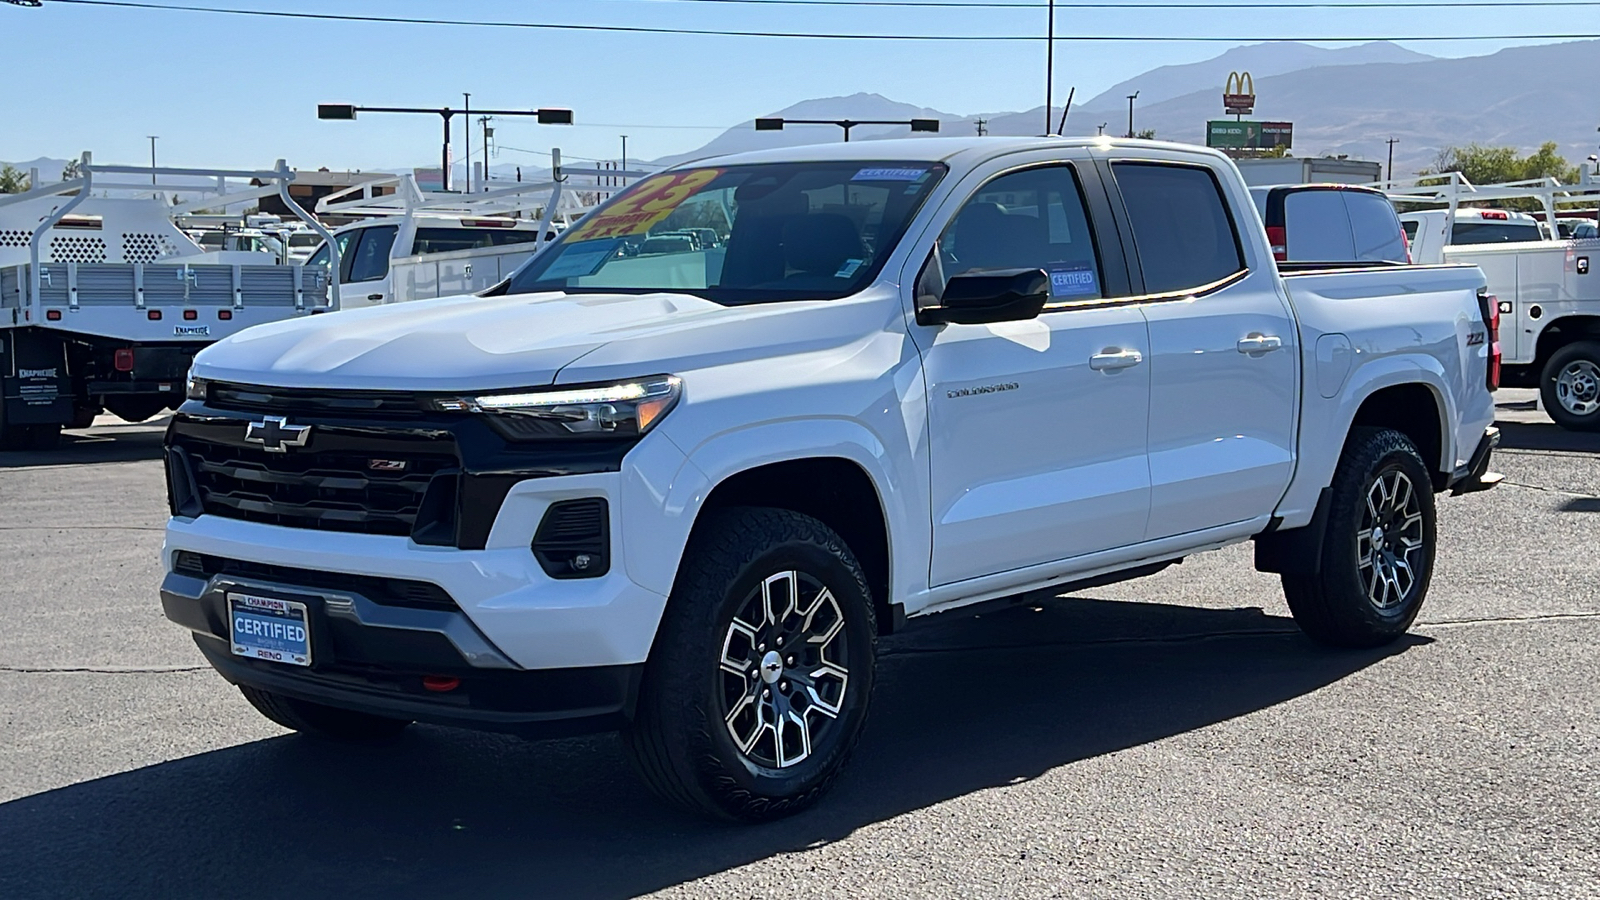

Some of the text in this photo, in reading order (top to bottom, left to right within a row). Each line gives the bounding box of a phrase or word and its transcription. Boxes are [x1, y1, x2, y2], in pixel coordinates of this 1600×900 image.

[859, 168, 922, 176] CERTIFIED
[600, 169, 719, 215] 23
[1052, 271, 1093, 286] CERTIFIED
[947, 382, 1019, 398] COLORADO
[369, 459, 407, 470] Z71
[248, 597, 284, 610] CHAMPION
[235, 617, 306, 642] CERTIFIED
[257, 650, 282, 660] RENO
